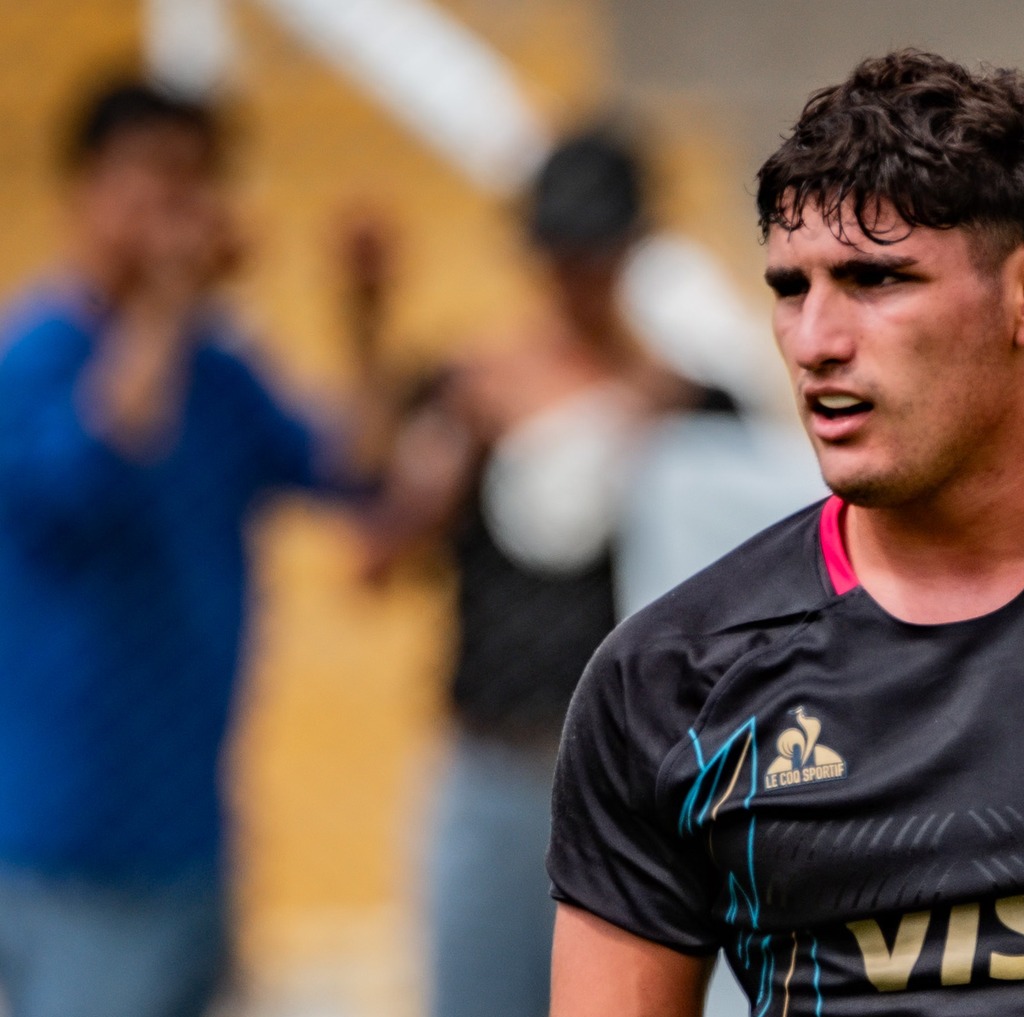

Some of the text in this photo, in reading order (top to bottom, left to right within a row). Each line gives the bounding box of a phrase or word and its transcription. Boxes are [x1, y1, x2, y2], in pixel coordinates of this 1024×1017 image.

[765, 763, 844, 788] LE COQ SPORTIF
